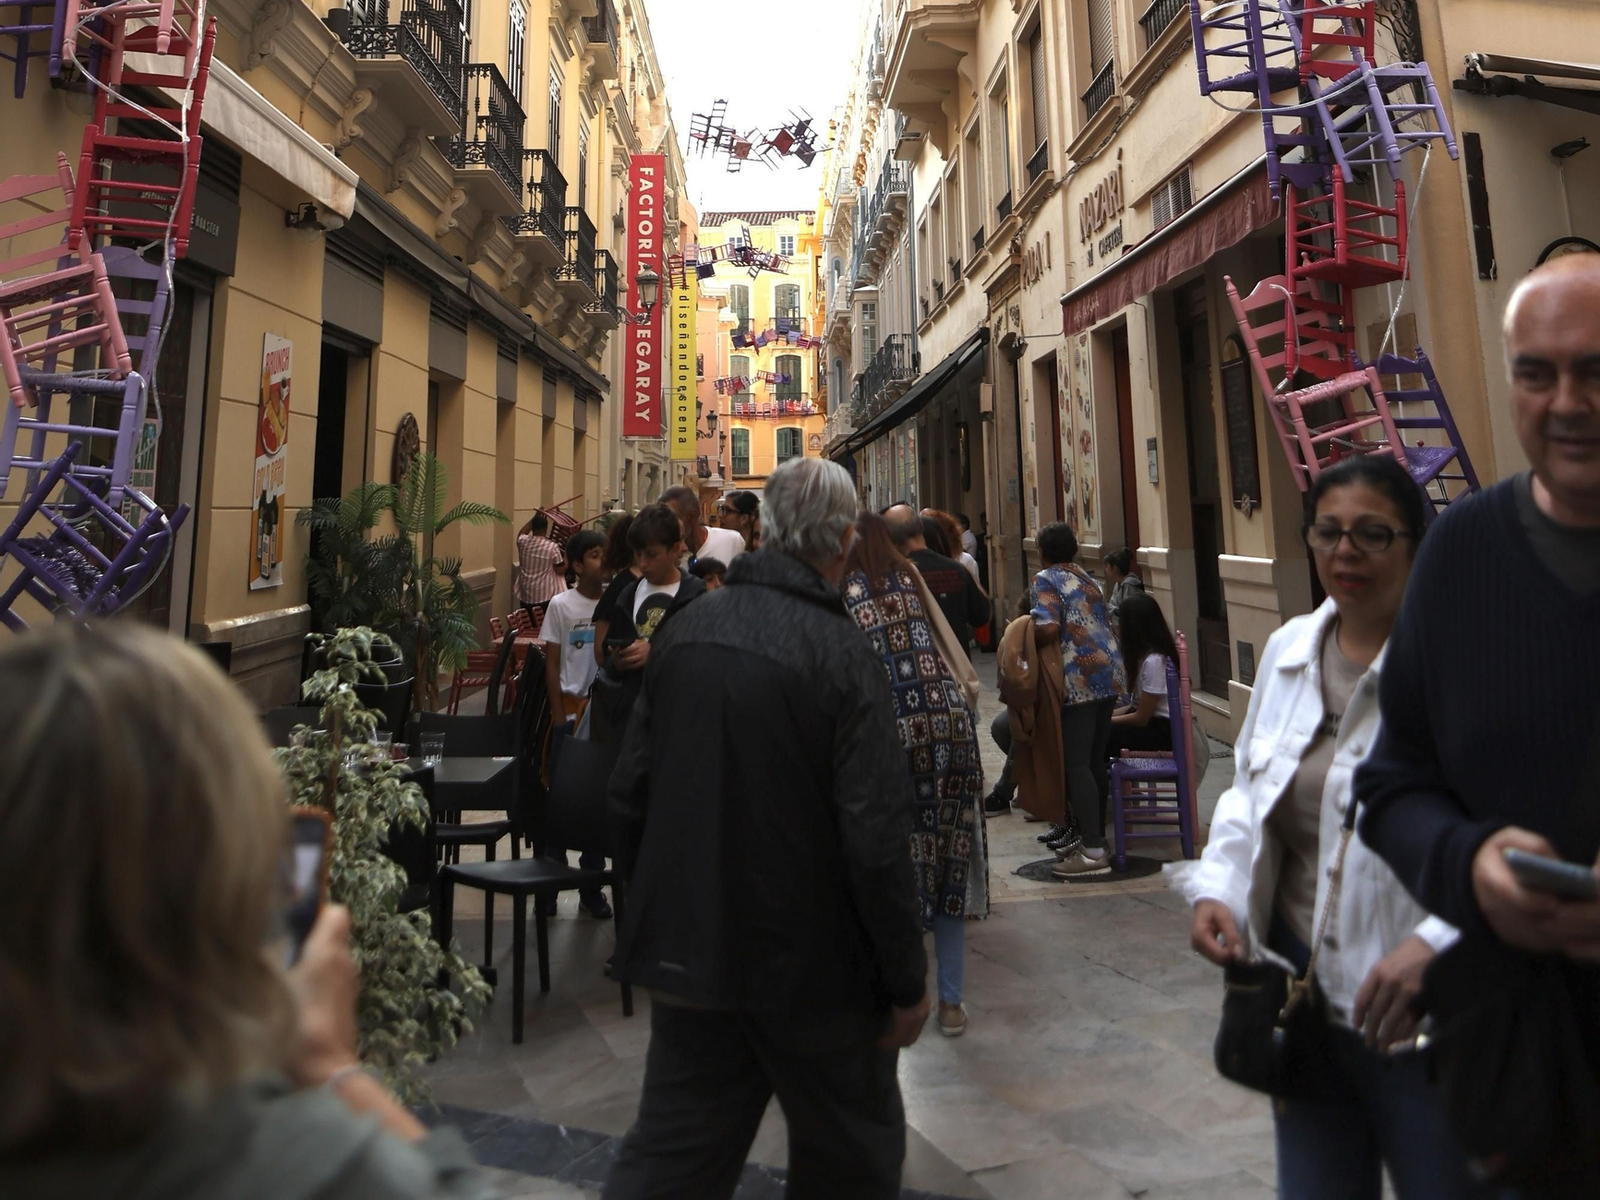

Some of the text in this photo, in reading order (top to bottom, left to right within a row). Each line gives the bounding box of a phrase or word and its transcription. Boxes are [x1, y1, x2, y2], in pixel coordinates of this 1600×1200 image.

[195, 215, 220, 237] ROASTER
[1079, 147, 1125, 245] NAZARÍ
[265, 346, 291, 376] BRUNCH
[678, 284, 690, 444] #diseñandoescena
